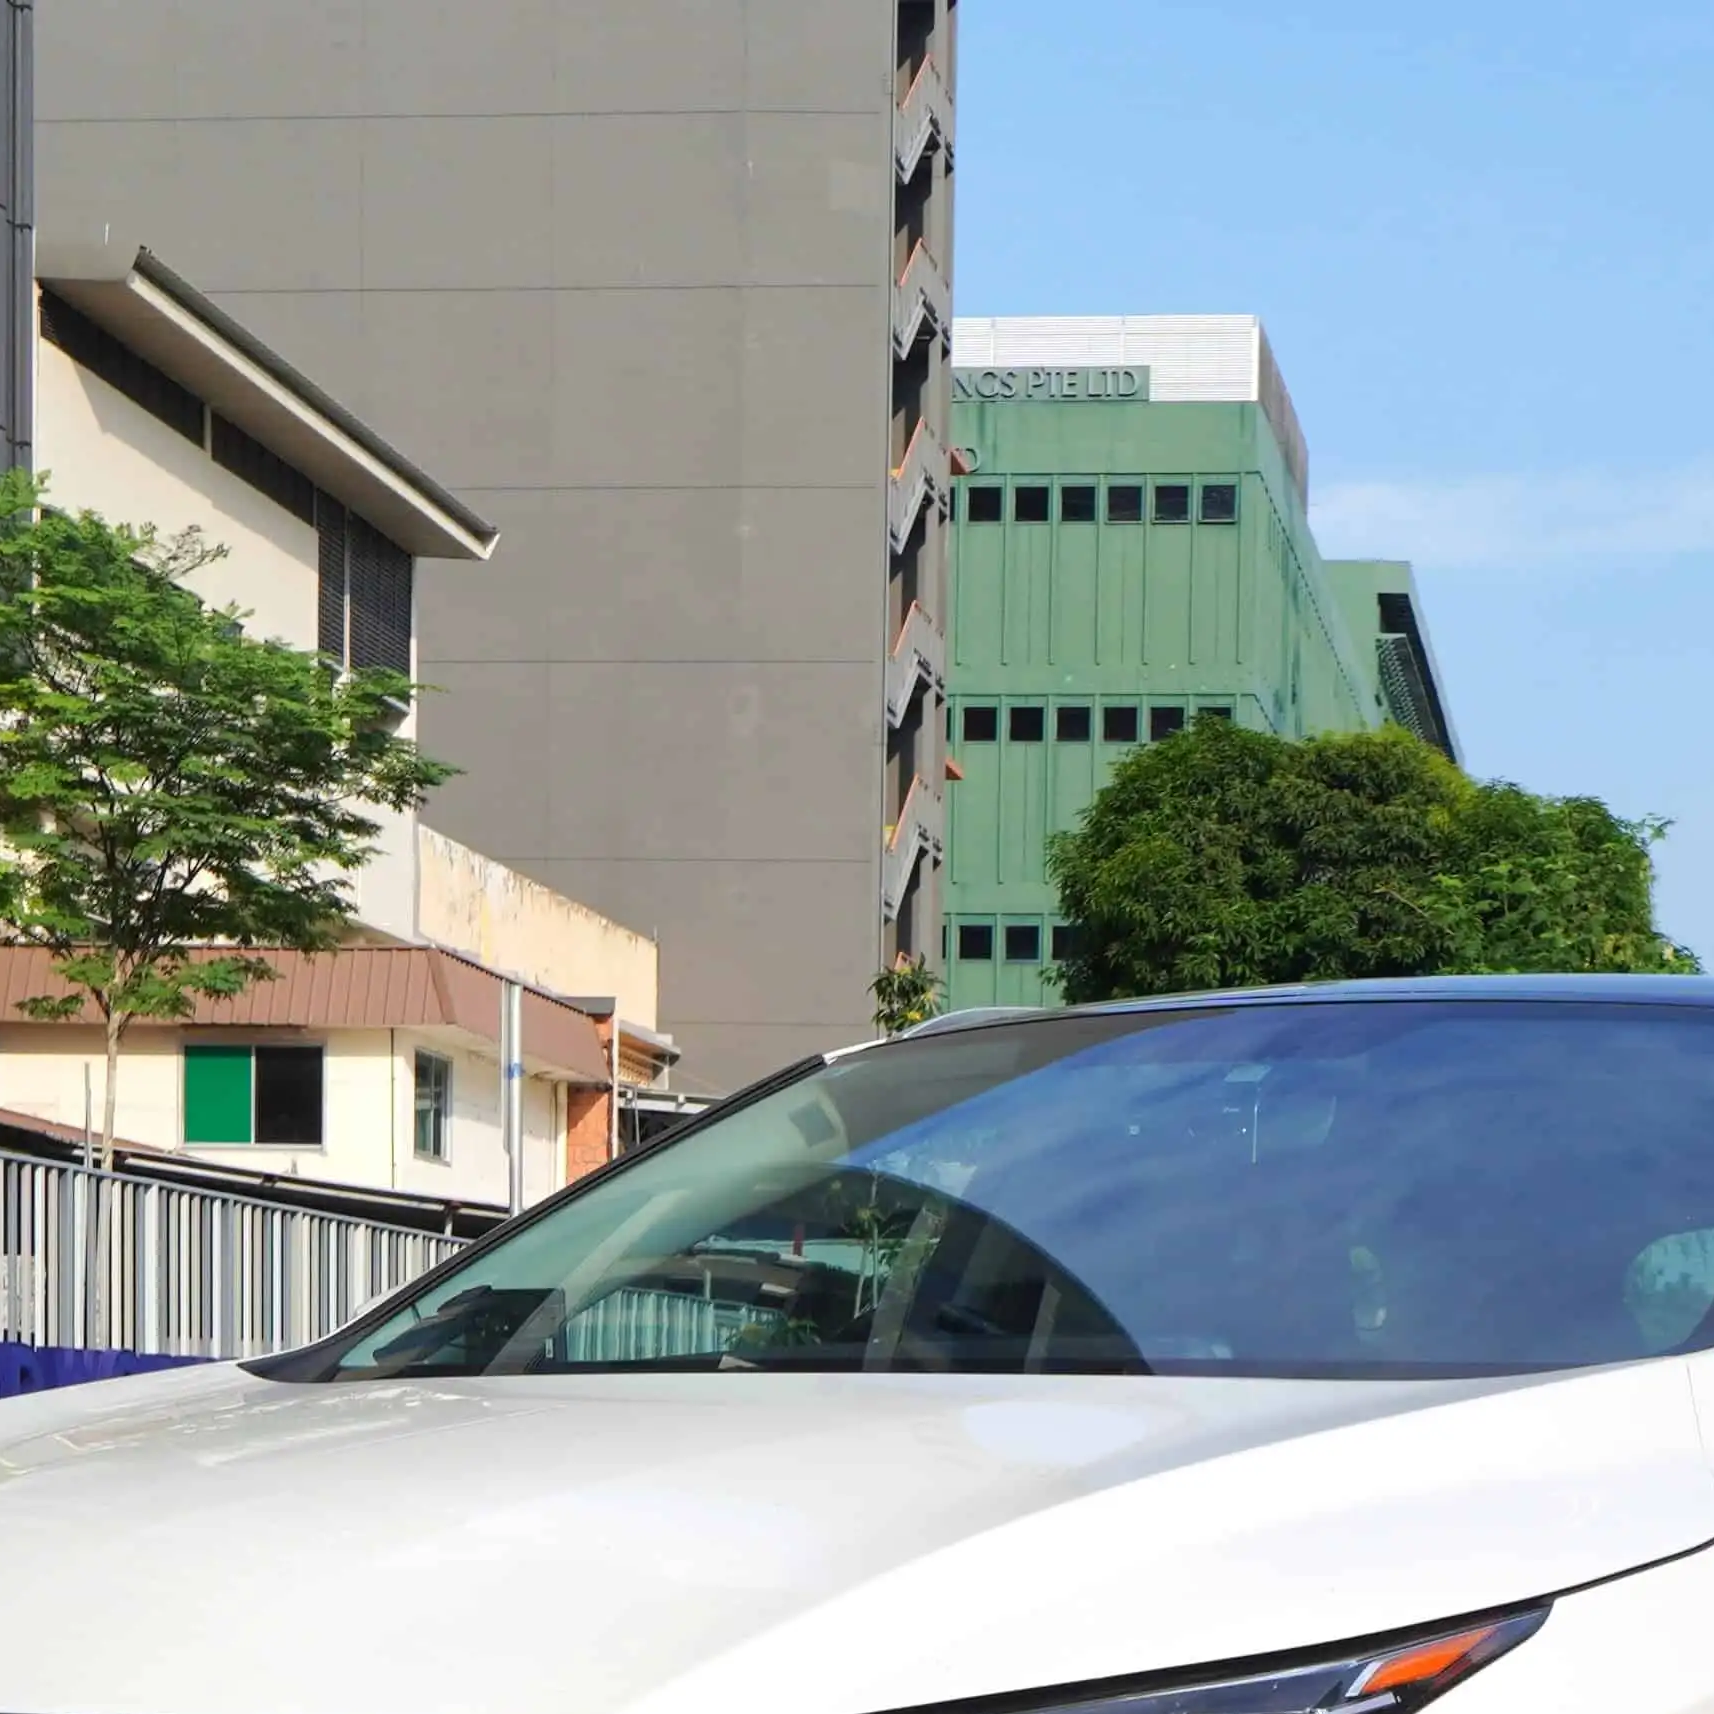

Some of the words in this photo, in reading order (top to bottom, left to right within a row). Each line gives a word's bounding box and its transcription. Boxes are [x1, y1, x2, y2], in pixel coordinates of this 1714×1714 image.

[952, 371, 1018, 399] NGS
[1026, 370, 1078, 398] PTE
[1087, 370, 1141, 398] LTD
